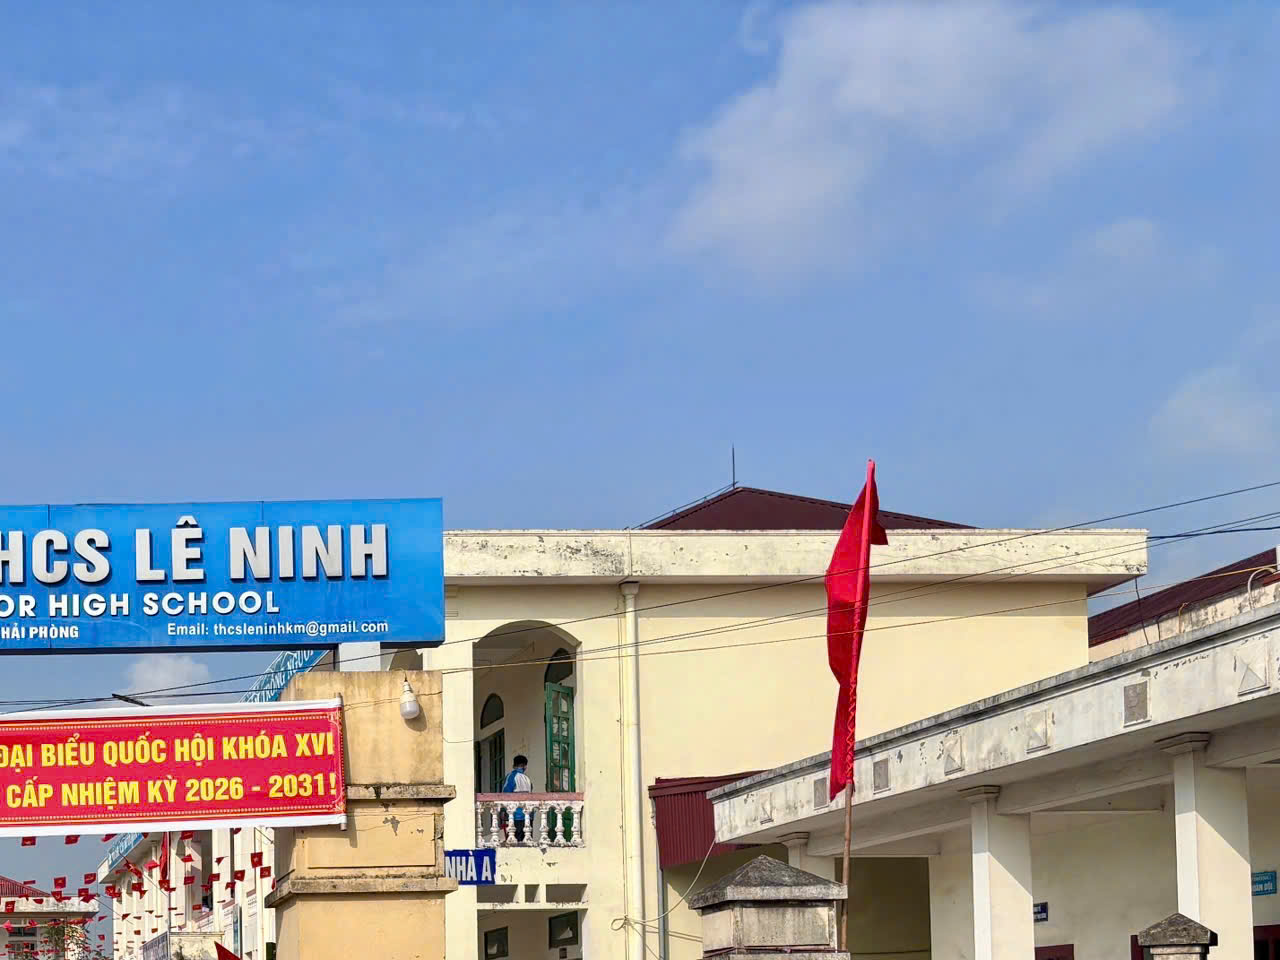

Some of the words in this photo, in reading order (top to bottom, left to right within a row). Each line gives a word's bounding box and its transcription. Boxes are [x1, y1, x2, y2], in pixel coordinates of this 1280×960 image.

[135, 515, 206, 582] LÊ
[229, 524, 389, 580] NINH
[49, 593, 130, 618] HIGH
[142, 590, 280, 616] SCHOOL
[1, 623, 25, 640] HẢI
[29, 624, 79, 639] PHÒNG
[167, 622, 209, 636] Email:
[41, 732, 95, 767] BIỂU
[103, 731, 167, 768] QUỐC
[174, 733, 215, 765] HỘI
[222, 730, 288, 760] KHÓA
[295, 731, 334, 758] XVI
[5, 776, 54, 808] CẤP
[61, 776, 140, 810] NHIỆM
[147, 774, 177, 804] KỲ
[185, 776, 244, 802] 2026
[268, 772, 338, 799] 2031!
[445, 850, 478, 881] NHÀ
[481, 855, 493, 881] A
